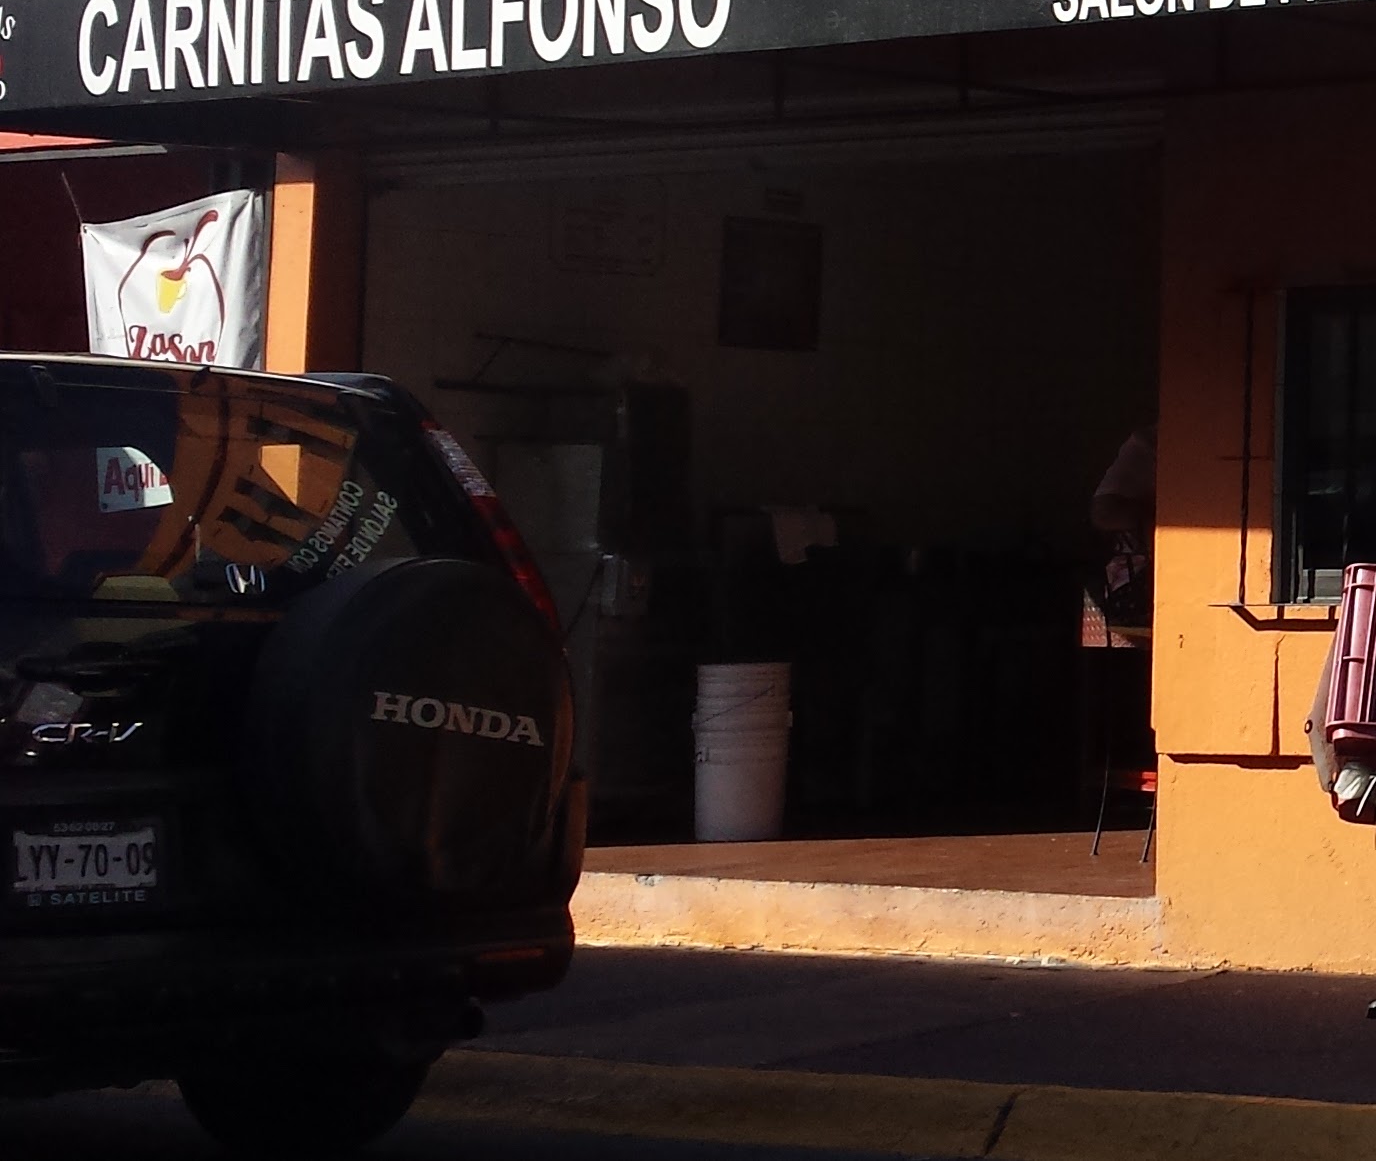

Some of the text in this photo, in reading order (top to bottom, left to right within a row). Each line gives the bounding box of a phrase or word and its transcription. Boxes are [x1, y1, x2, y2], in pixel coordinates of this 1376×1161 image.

[370, 691, 545, 748] HONDA
[31, 722, 144, 745] CR-V
[49, 889, 147, 905] SATELITE
